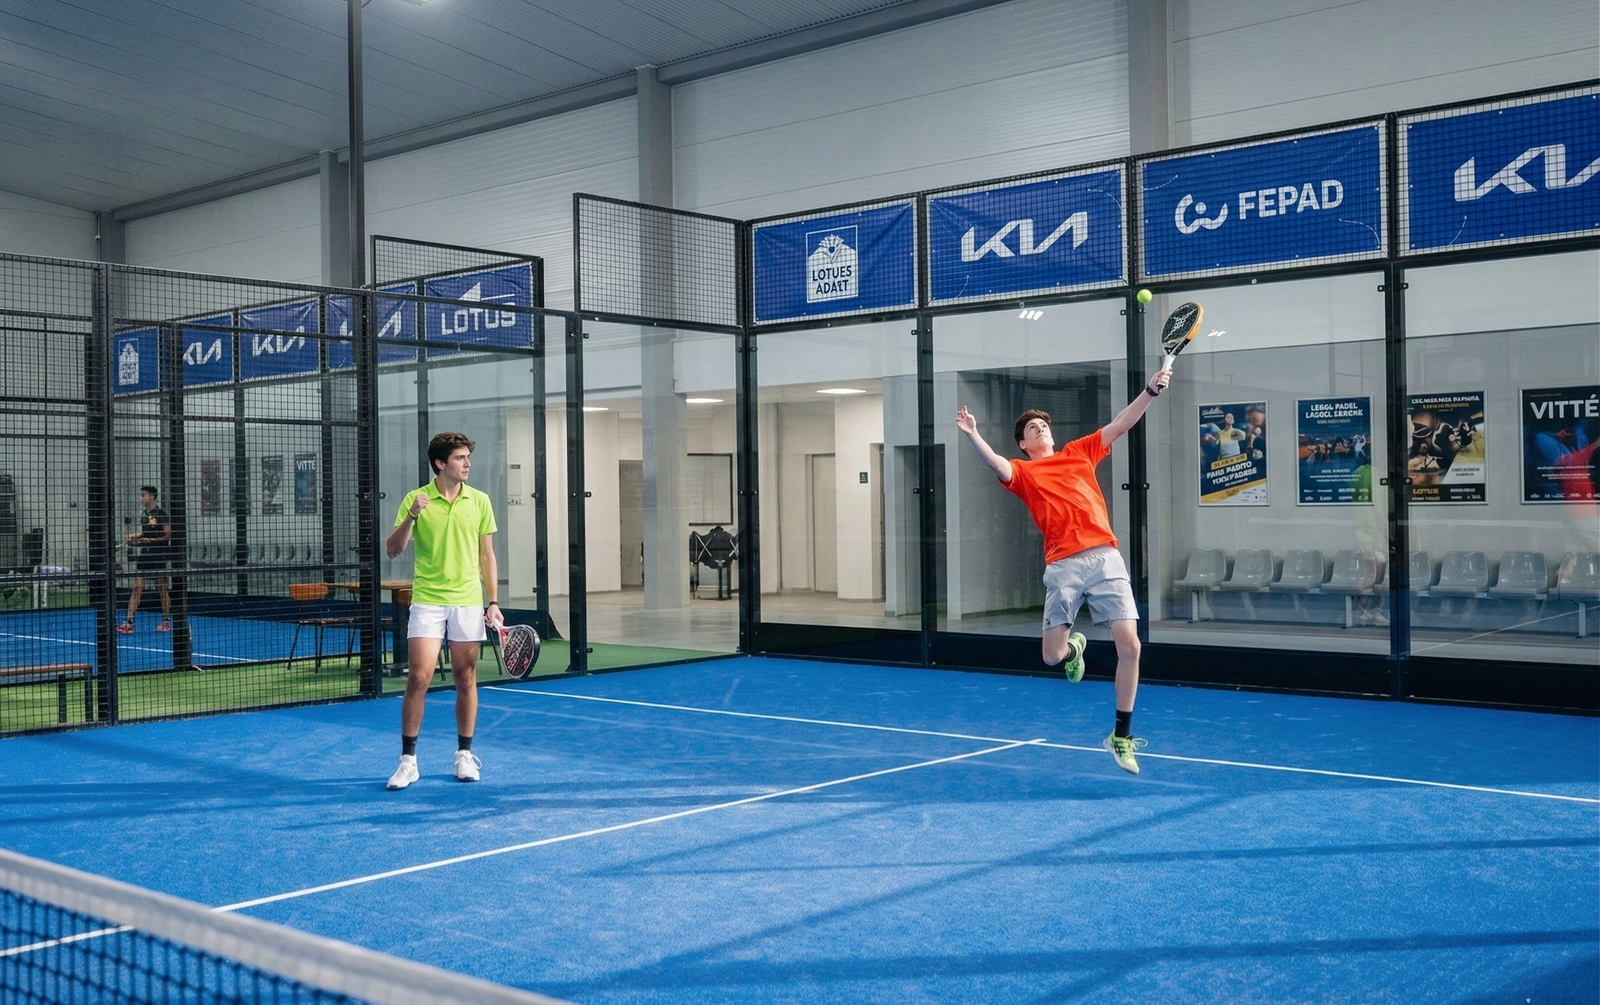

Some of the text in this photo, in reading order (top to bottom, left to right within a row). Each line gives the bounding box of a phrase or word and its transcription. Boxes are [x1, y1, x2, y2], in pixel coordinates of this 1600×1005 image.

[1238, 179, 1344, 220] FEPAD
[961, 211, 1088, 262] KIA
[812, 265, 852, 281] LOTUES
[441, 301, 516, 336] LOTUS
[1335, 402, 1358, 410] PADEL
[1530, 394, 1599, 419] VITTÉ
